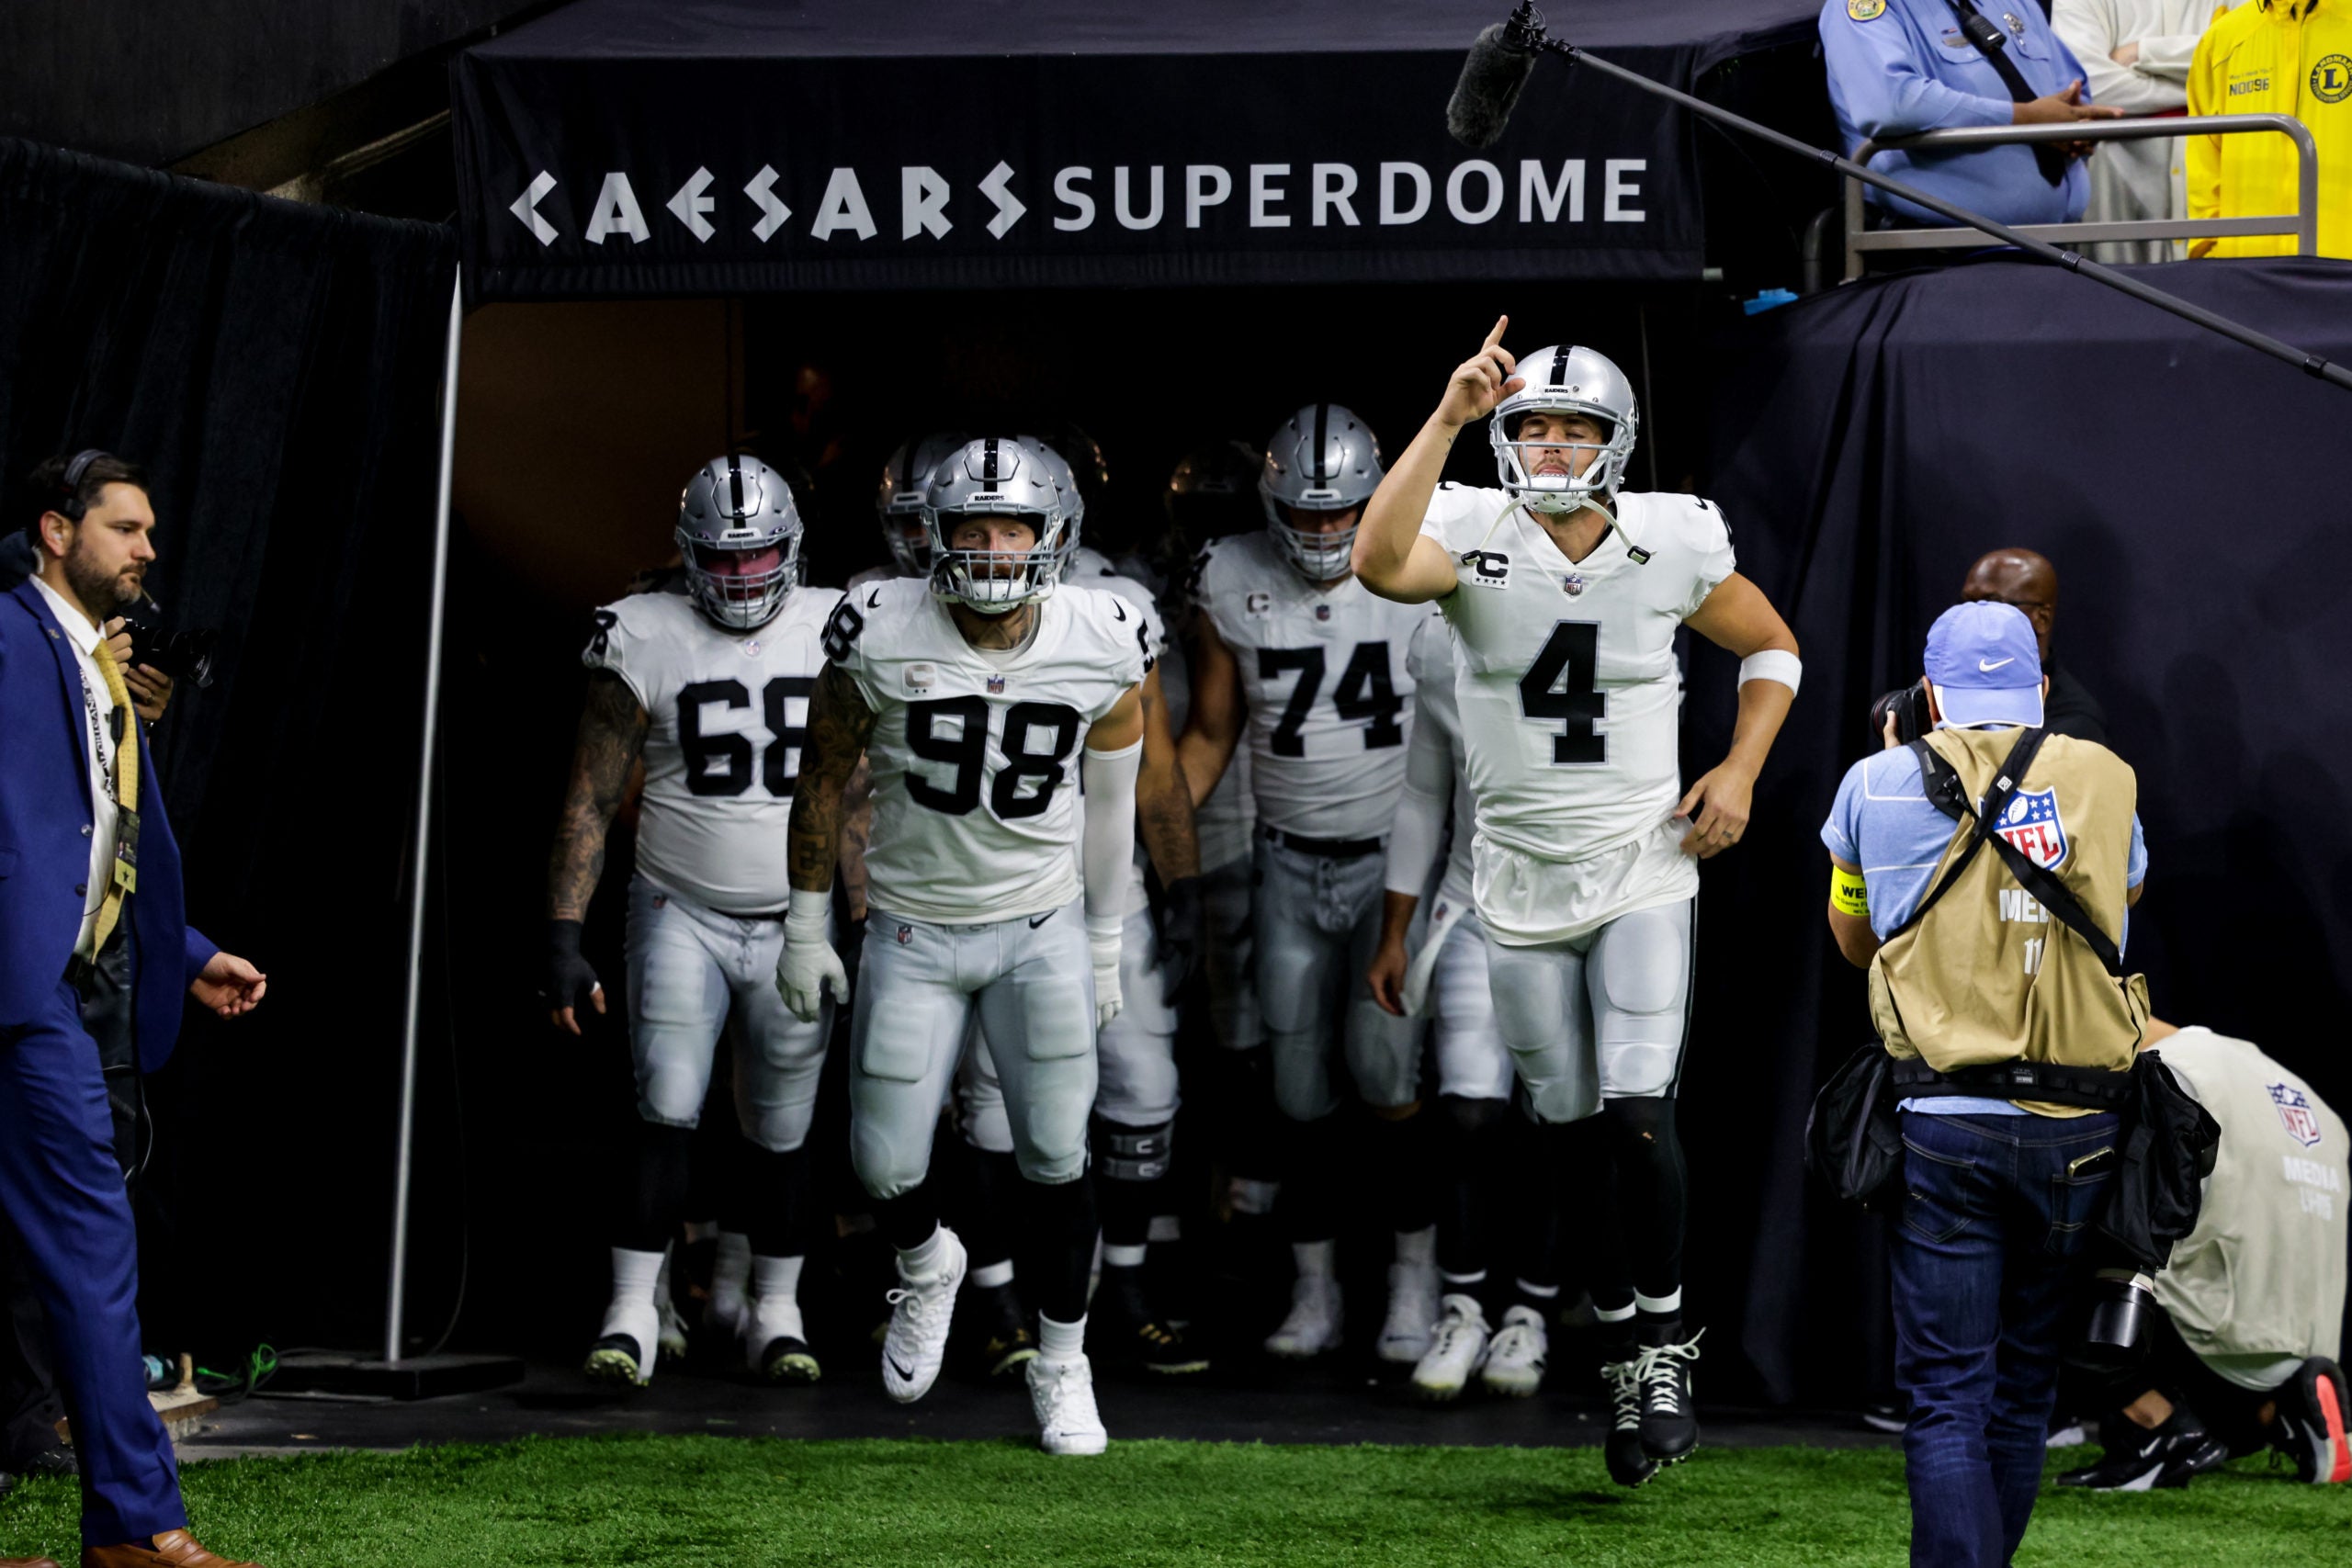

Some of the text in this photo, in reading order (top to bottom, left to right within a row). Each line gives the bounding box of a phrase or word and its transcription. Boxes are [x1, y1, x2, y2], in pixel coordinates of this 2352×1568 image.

[2323, 68, 2343, 89] L
[509, 158, 1647, 247] CAESARS SUPERDOME
[1476, 551, 1510, 579] C
[904, 664, 935, 688] C
[1518, 619, 1609, 766] 4
[1257, 639, 1404, 758] 74
[676, 676, 819, 797] 68
[904, 694, 1080, 820] 98
[1841, 884, 1868, 899] WE
[2280, 1107, 2317, 1138] NFL
[2283, 1156, 2341, 1192] MEDIA
